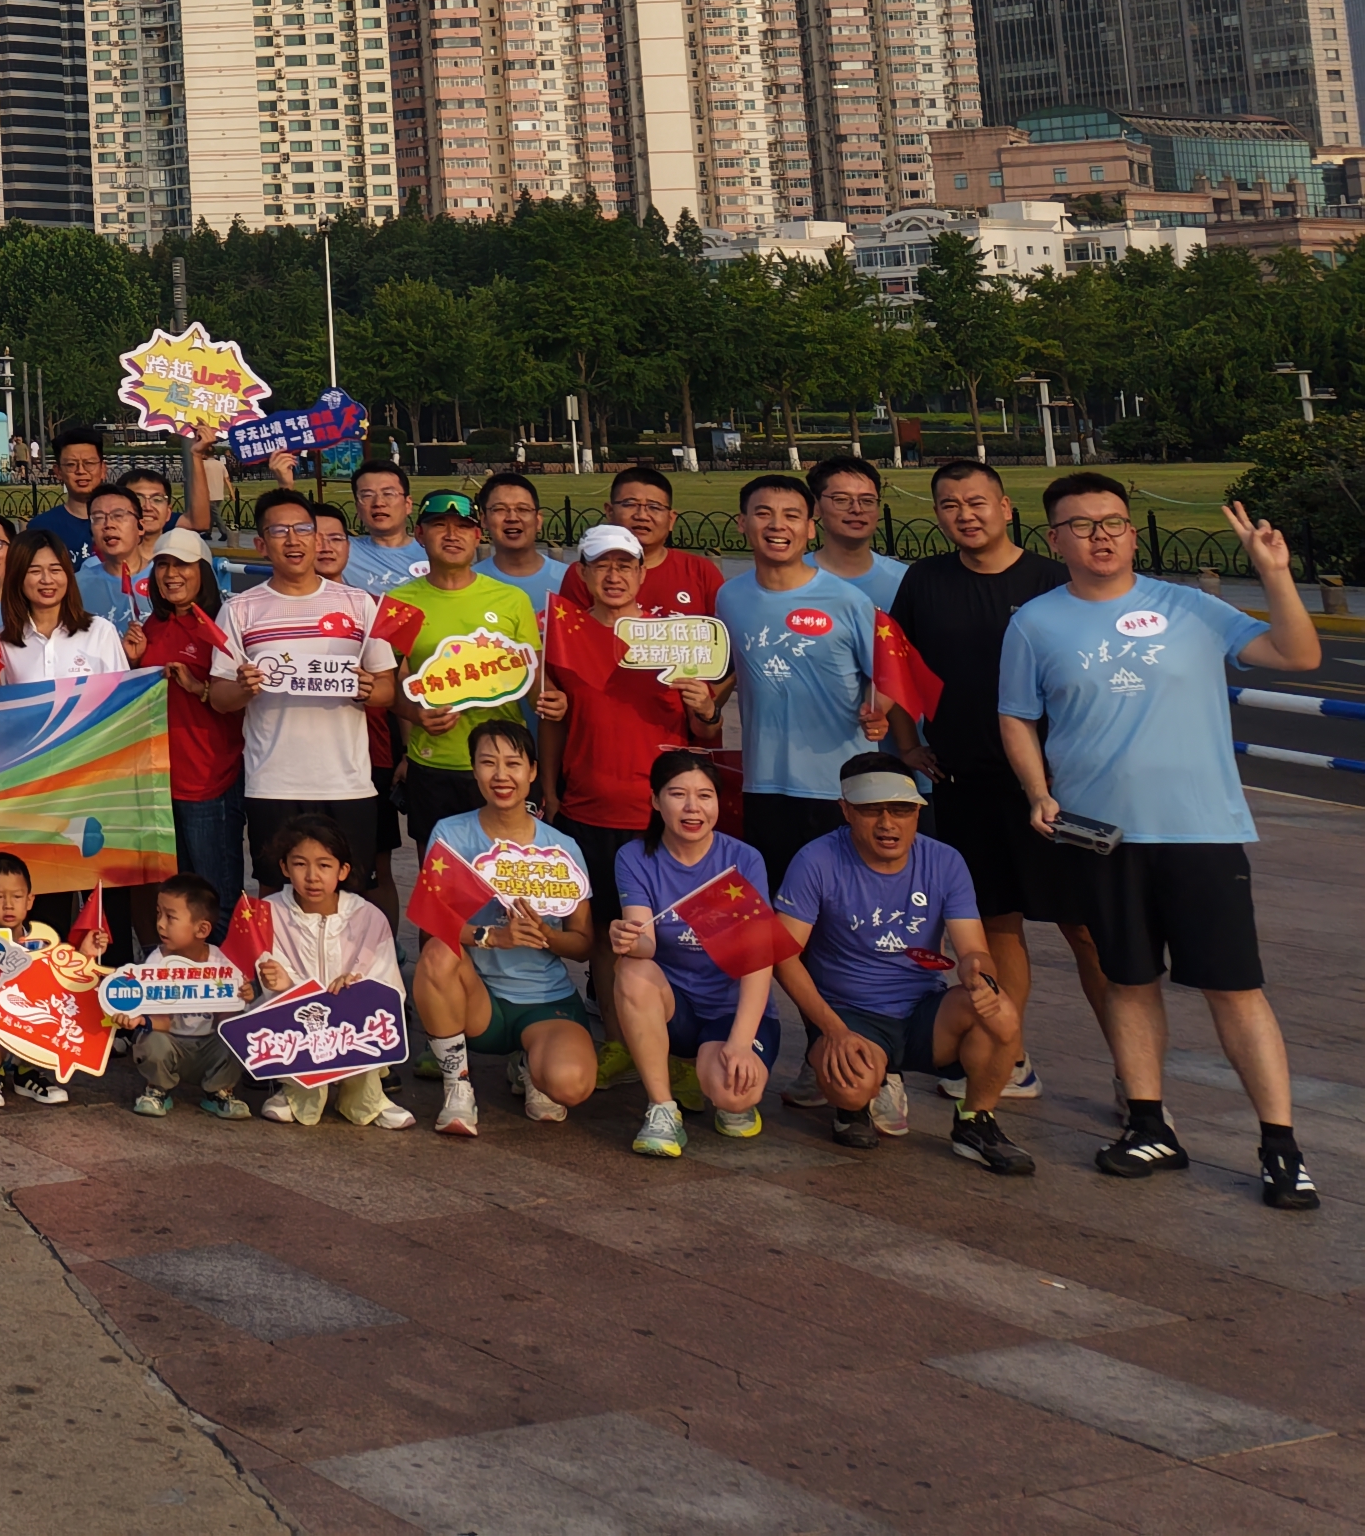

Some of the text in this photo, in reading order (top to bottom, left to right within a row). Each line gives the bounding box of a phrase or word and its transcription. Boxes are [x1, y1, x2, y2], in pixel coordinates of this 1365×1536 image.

[144, 353, 242, 394] 跨越山嗨
[142, 381, 240, 417] 一起奔跑
[234, 421, 283, 443] 学无止境
[629, 644, 712, 665] 我就骄傲
[307, 659, 356, 674] 全山大
[289, 677, 356, 693] 醉靓的仔
[495, 859, 569, 880] 放弃不难
[140, 966, 234, 981] 只要我跑的快
[145, 984, 235, 1001] 就追不上我
